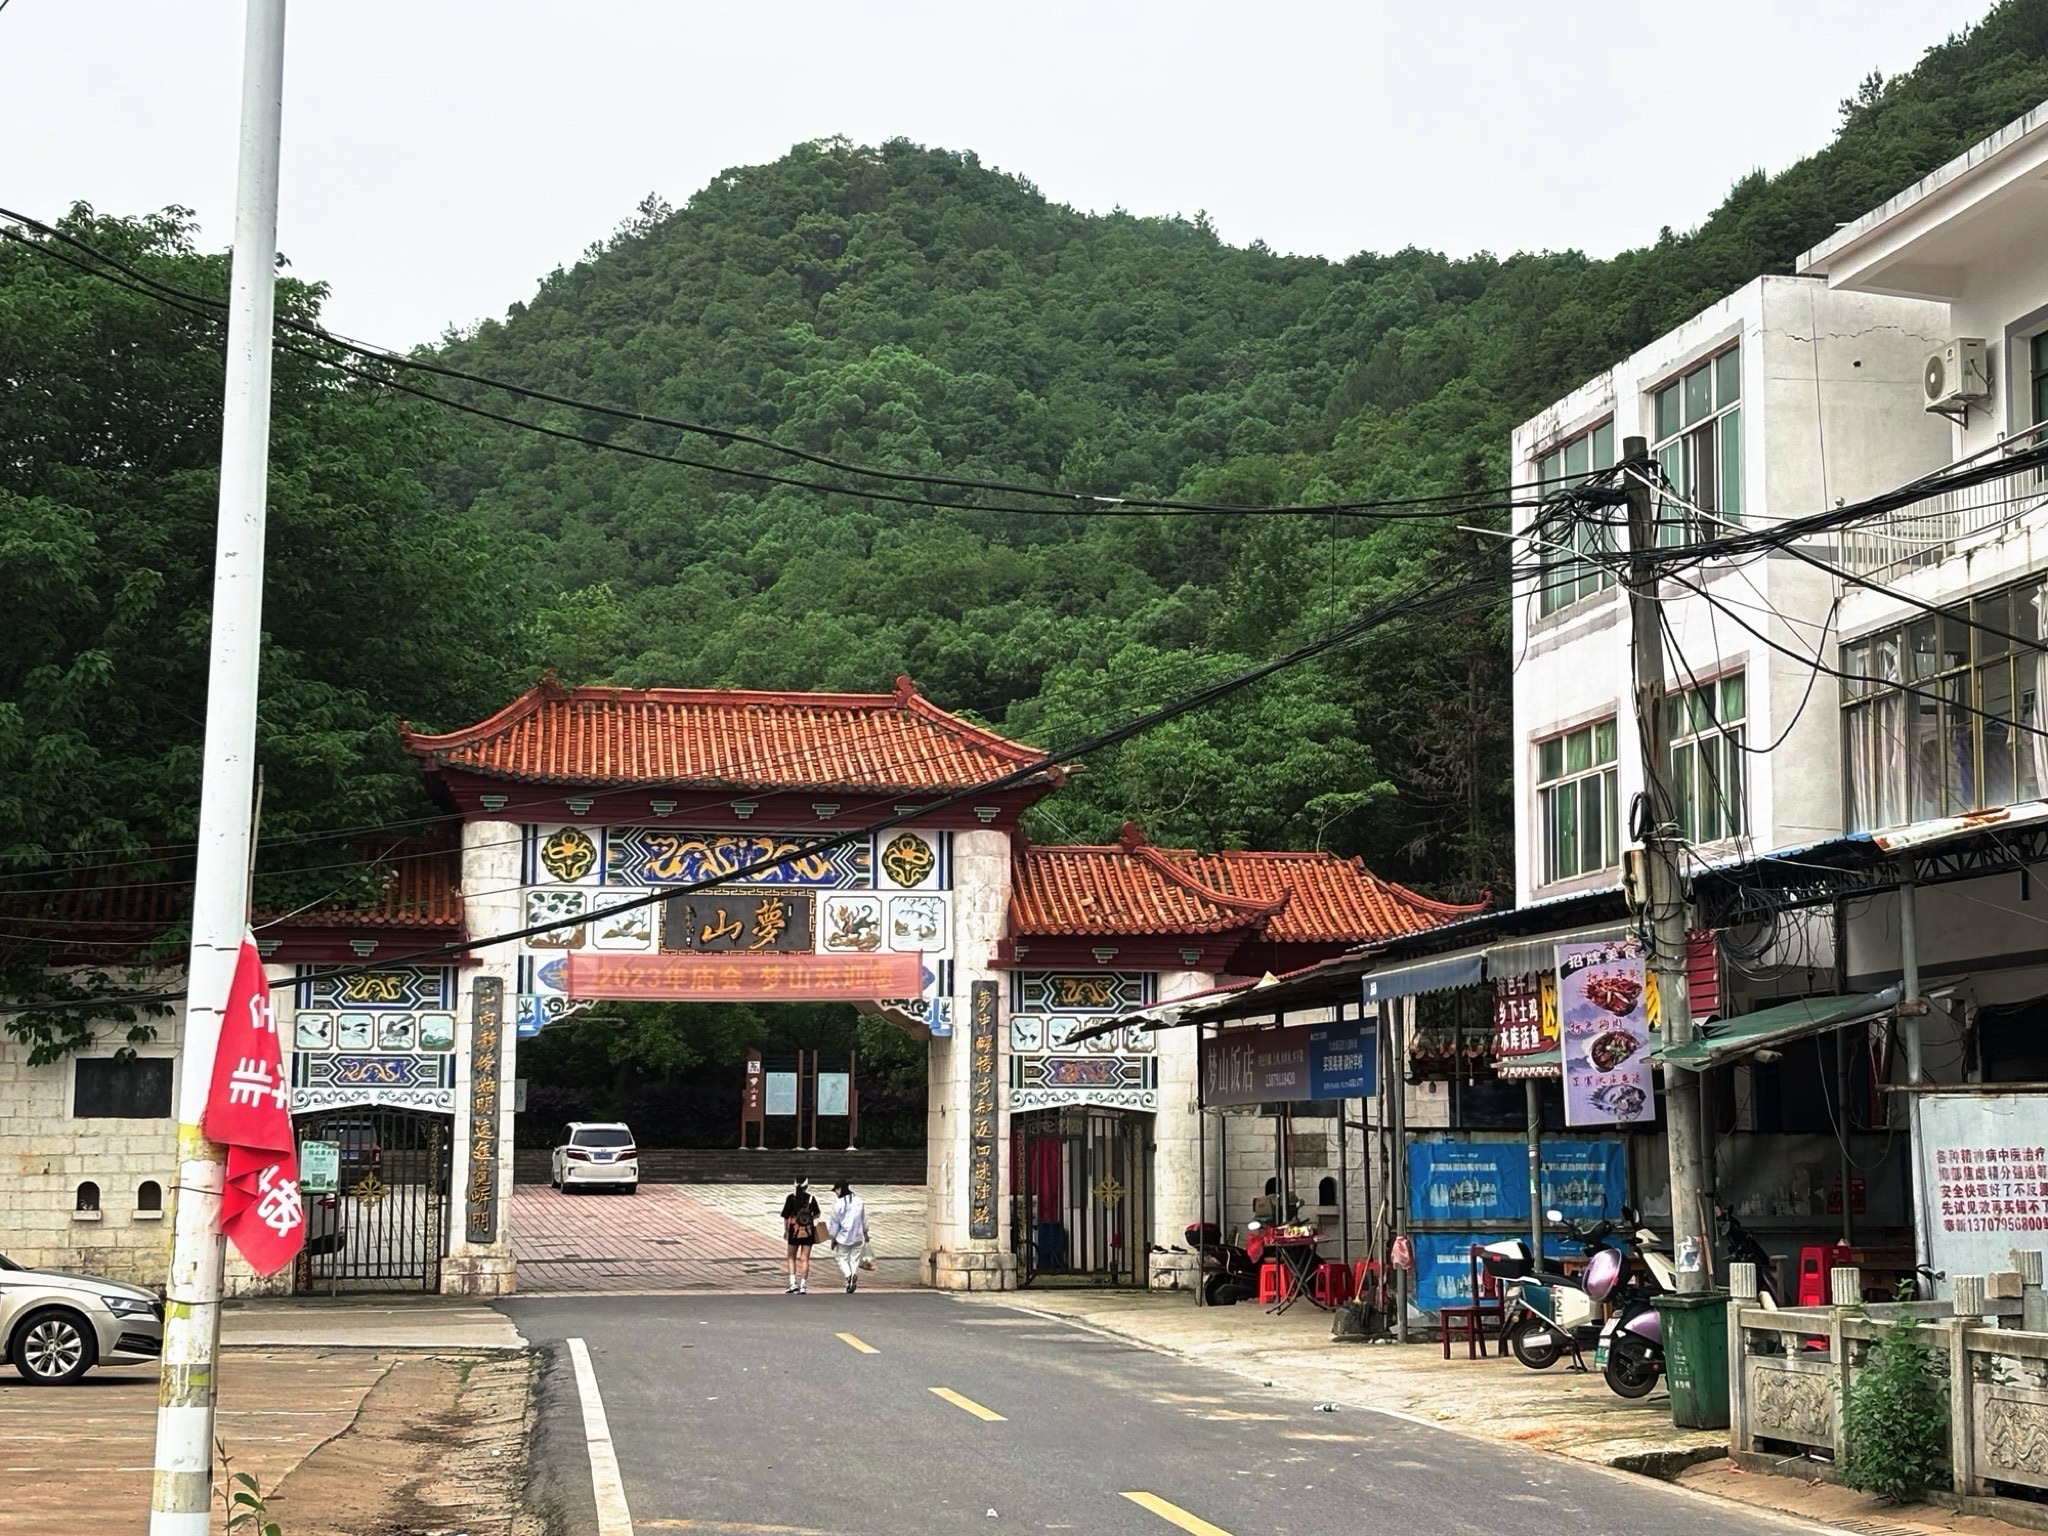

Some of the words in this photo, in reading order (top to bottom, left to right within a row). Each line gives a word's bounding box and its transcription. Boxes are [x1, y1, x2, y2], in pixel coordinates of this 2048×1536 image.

[1568, 944, 1638, 969] 招牌美食
[599, 964, 743, 991] 2023年庙会
[759, 963, 896, 990] 梦山欢迎您
[1499, 998, 1539, 1024] 乡下土鸡
[1500, 1025, 1541, 1051] 水库活鱼
[1207, 1043, 1255, 1096] 梦山饭店
[1937, 1147, 2046, 1164] 各种精神病中医治疗
[1939, 1164, 2048, 1181] 抑郁焦虑精分强迫等
